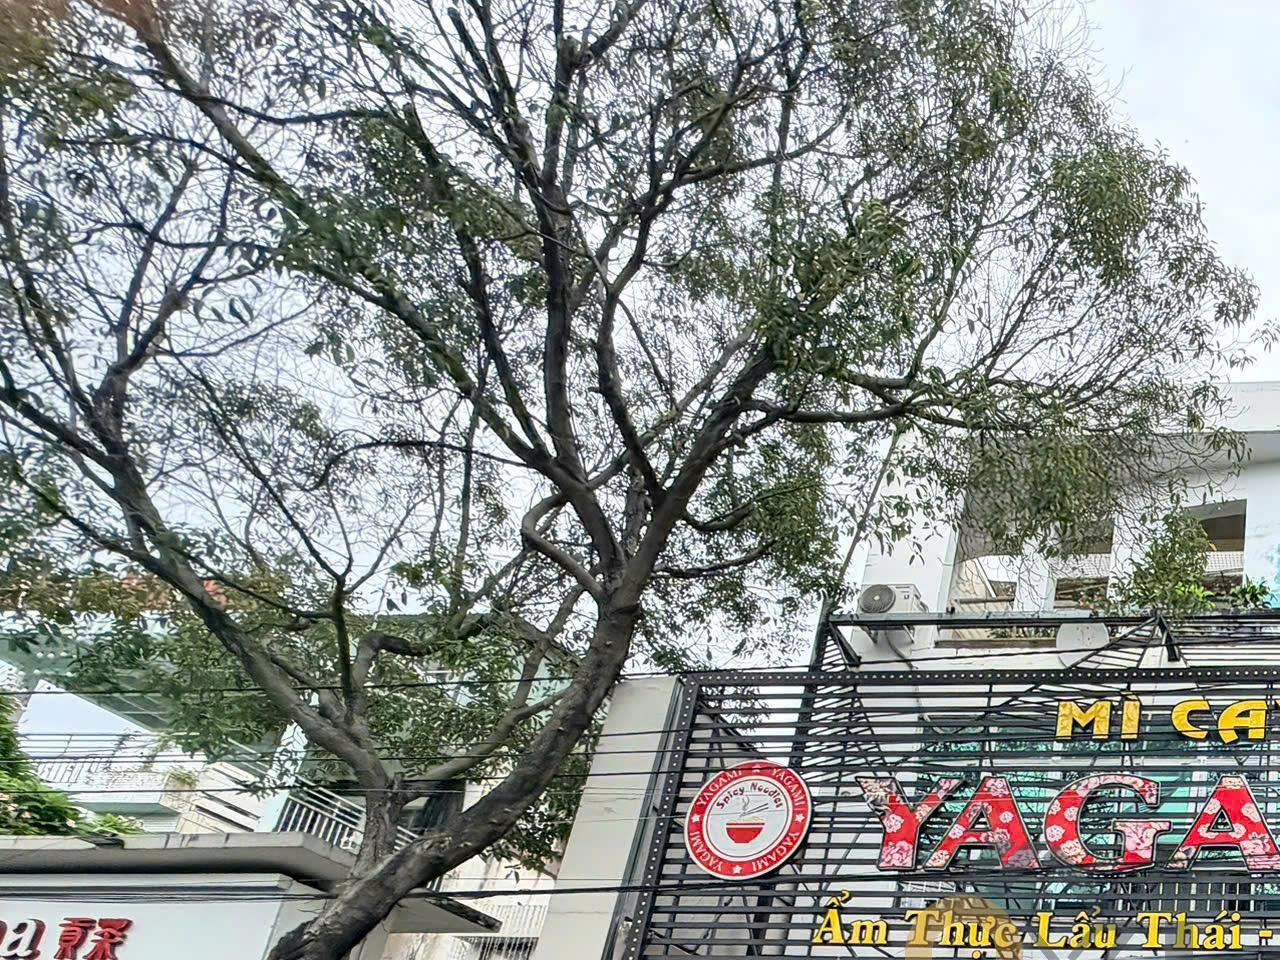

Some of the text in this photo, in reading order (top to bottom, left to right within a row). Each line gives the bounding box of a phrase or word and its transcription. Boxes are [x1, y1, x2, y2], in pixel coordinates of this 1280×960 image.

[716, 781, 784, 810] Spicy Noodles
[812, 889, 888, 945] Ẩm
[903, 908, 1022, 960] Thực
[1034, 905, 1117, 949] Lẩu
[1136, 909, 1243, 950] Thái
